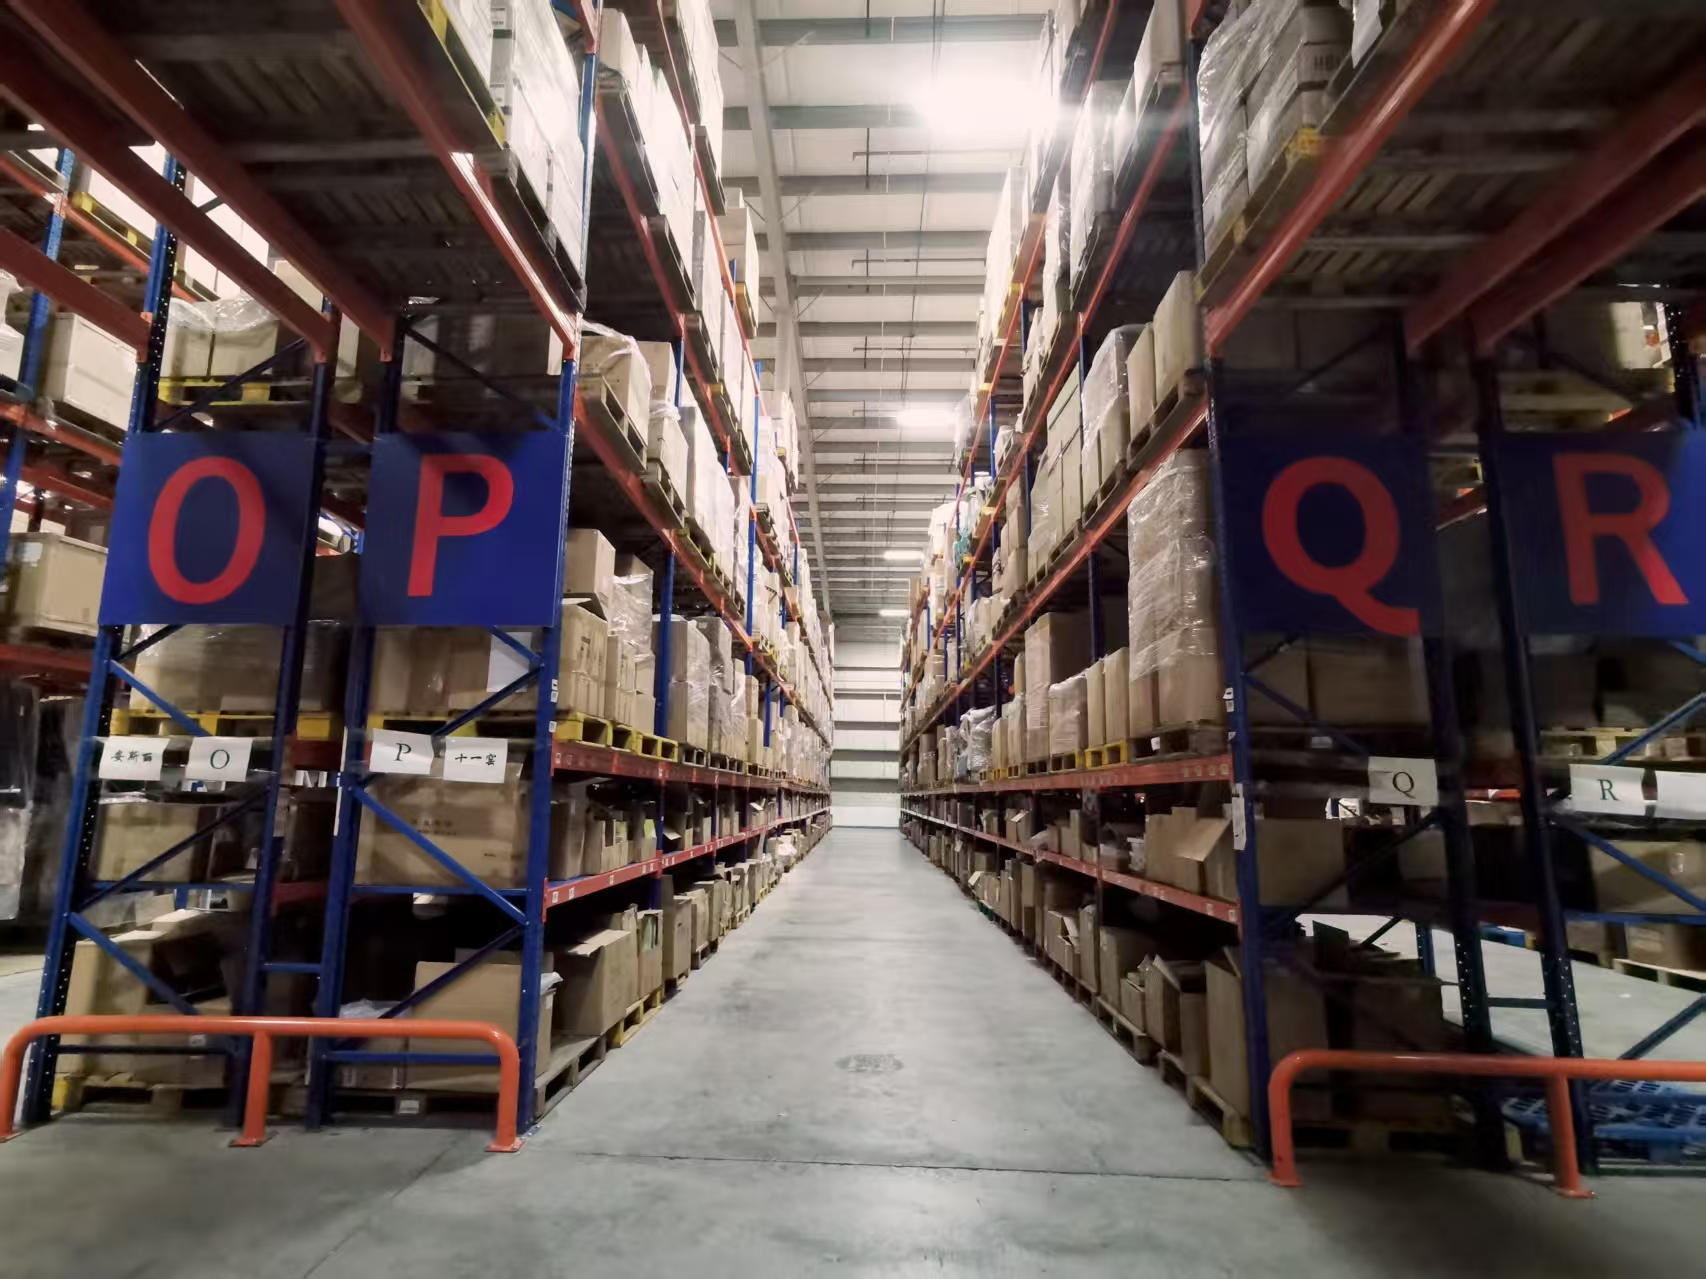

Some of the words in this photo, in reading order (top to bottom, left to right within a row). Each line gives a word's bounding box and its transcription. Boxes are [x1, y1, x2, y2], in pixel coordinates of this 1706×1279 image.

[148, 456, 266, 604] O
[407, 453, 514, 597] P
[1262, 456, 1420, 636] Q
[1552, 452, 1689, 605] R
[210, 748, 230, 769] O
[393, 742, 412, 762] P
[1392, 771, 1416, 799] Q
[1597, 778, 1620, 801] R
